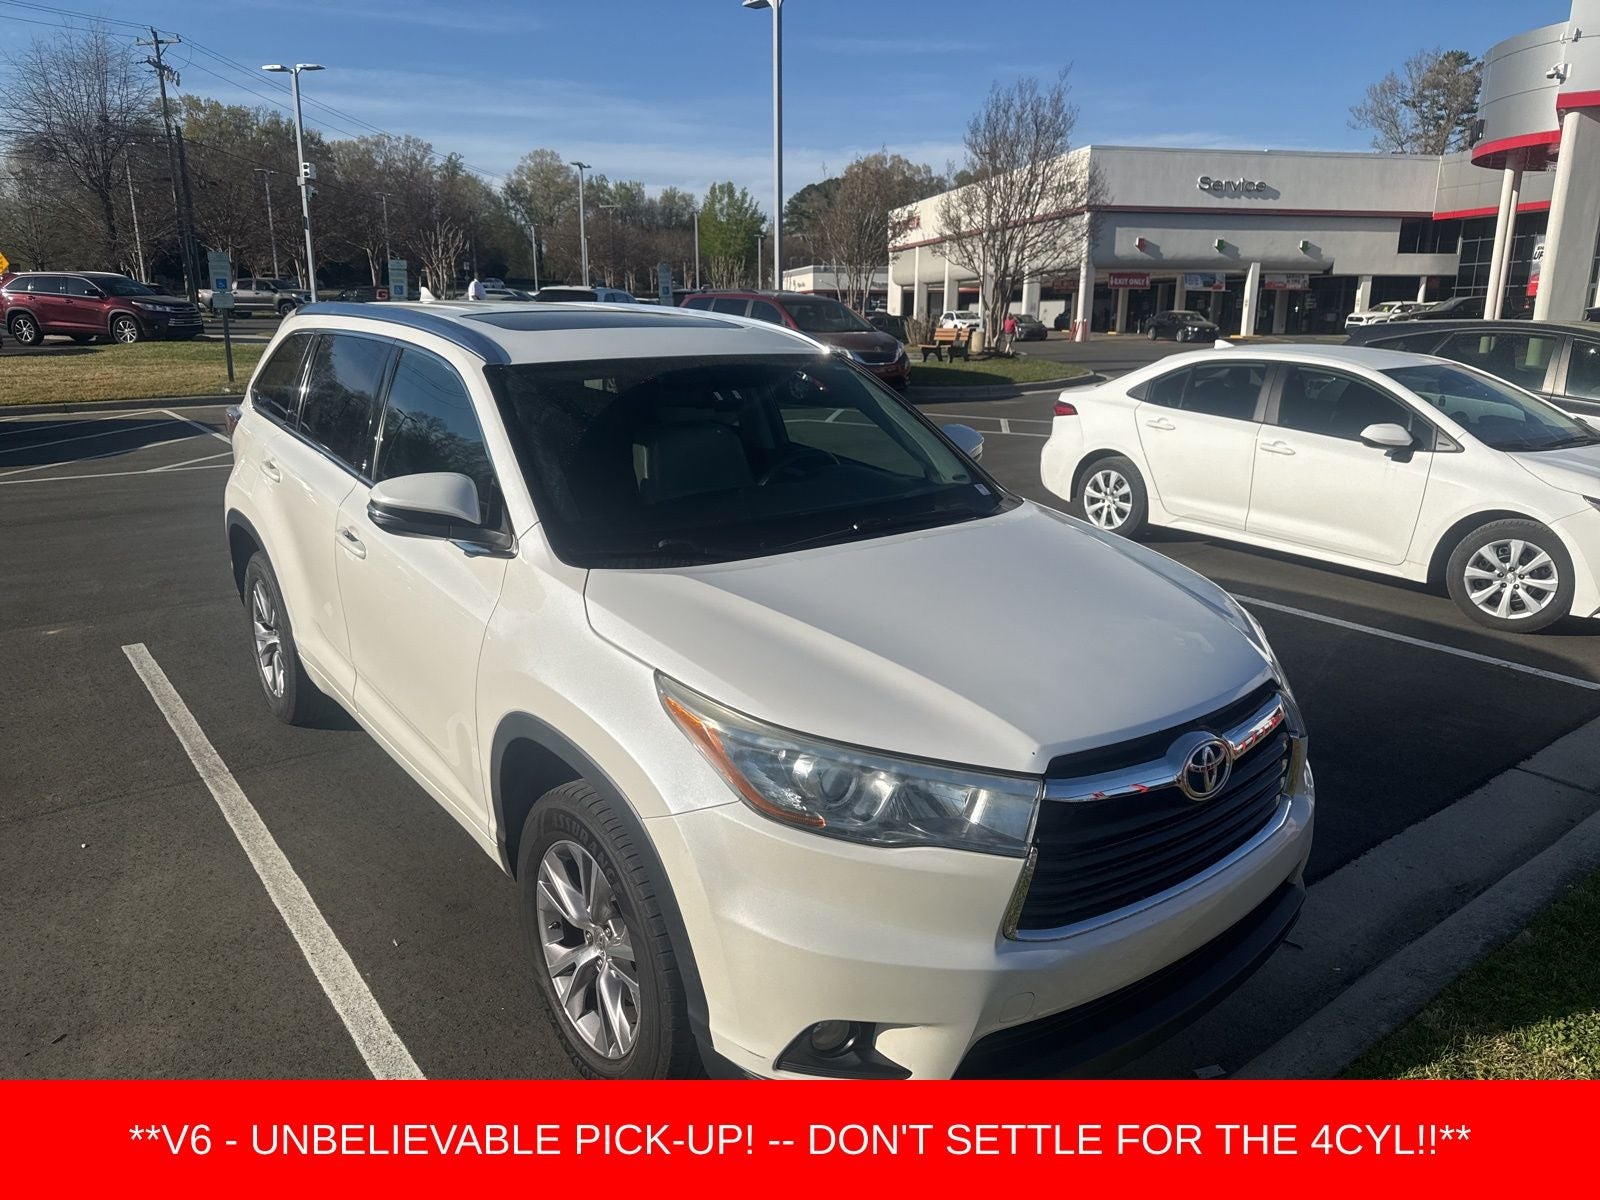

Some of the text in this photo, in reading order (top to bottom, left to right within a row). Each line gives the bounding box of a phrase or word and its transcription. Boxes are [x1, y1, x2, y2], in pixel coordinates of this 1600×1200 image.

[1197, 175, 1266, 193] Service
[1114, 278, 1146, 286] EXIT ONLY
[551, 812, 623, 895] ASSURANCE
